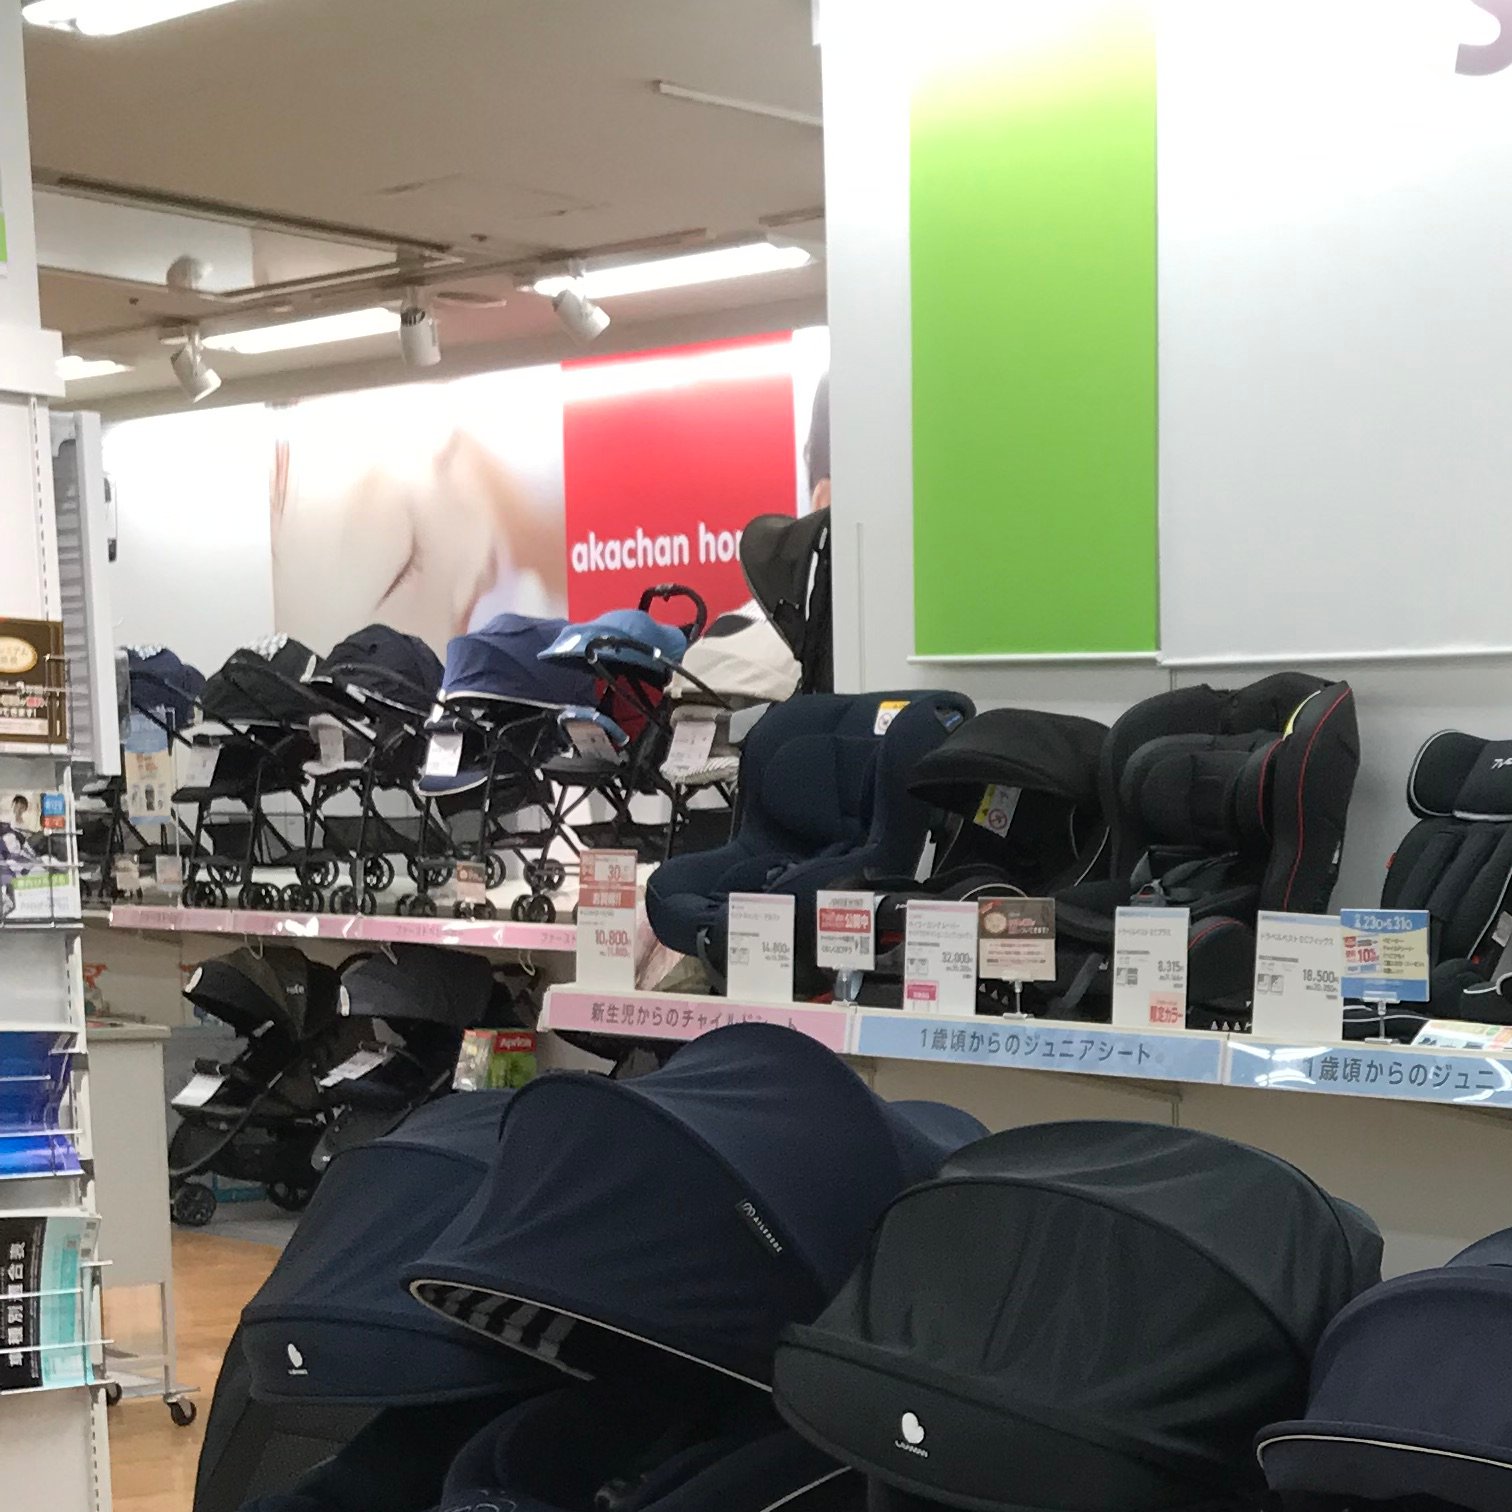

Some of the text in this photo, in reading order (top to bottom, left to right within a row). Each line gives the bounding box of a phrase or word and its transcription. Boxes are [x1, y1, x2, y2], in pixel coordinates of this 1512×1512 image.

[571, 526, 690, 573] akachan
[920, 1027, 1151, 1064] 1歳頃からのジュニアシート
